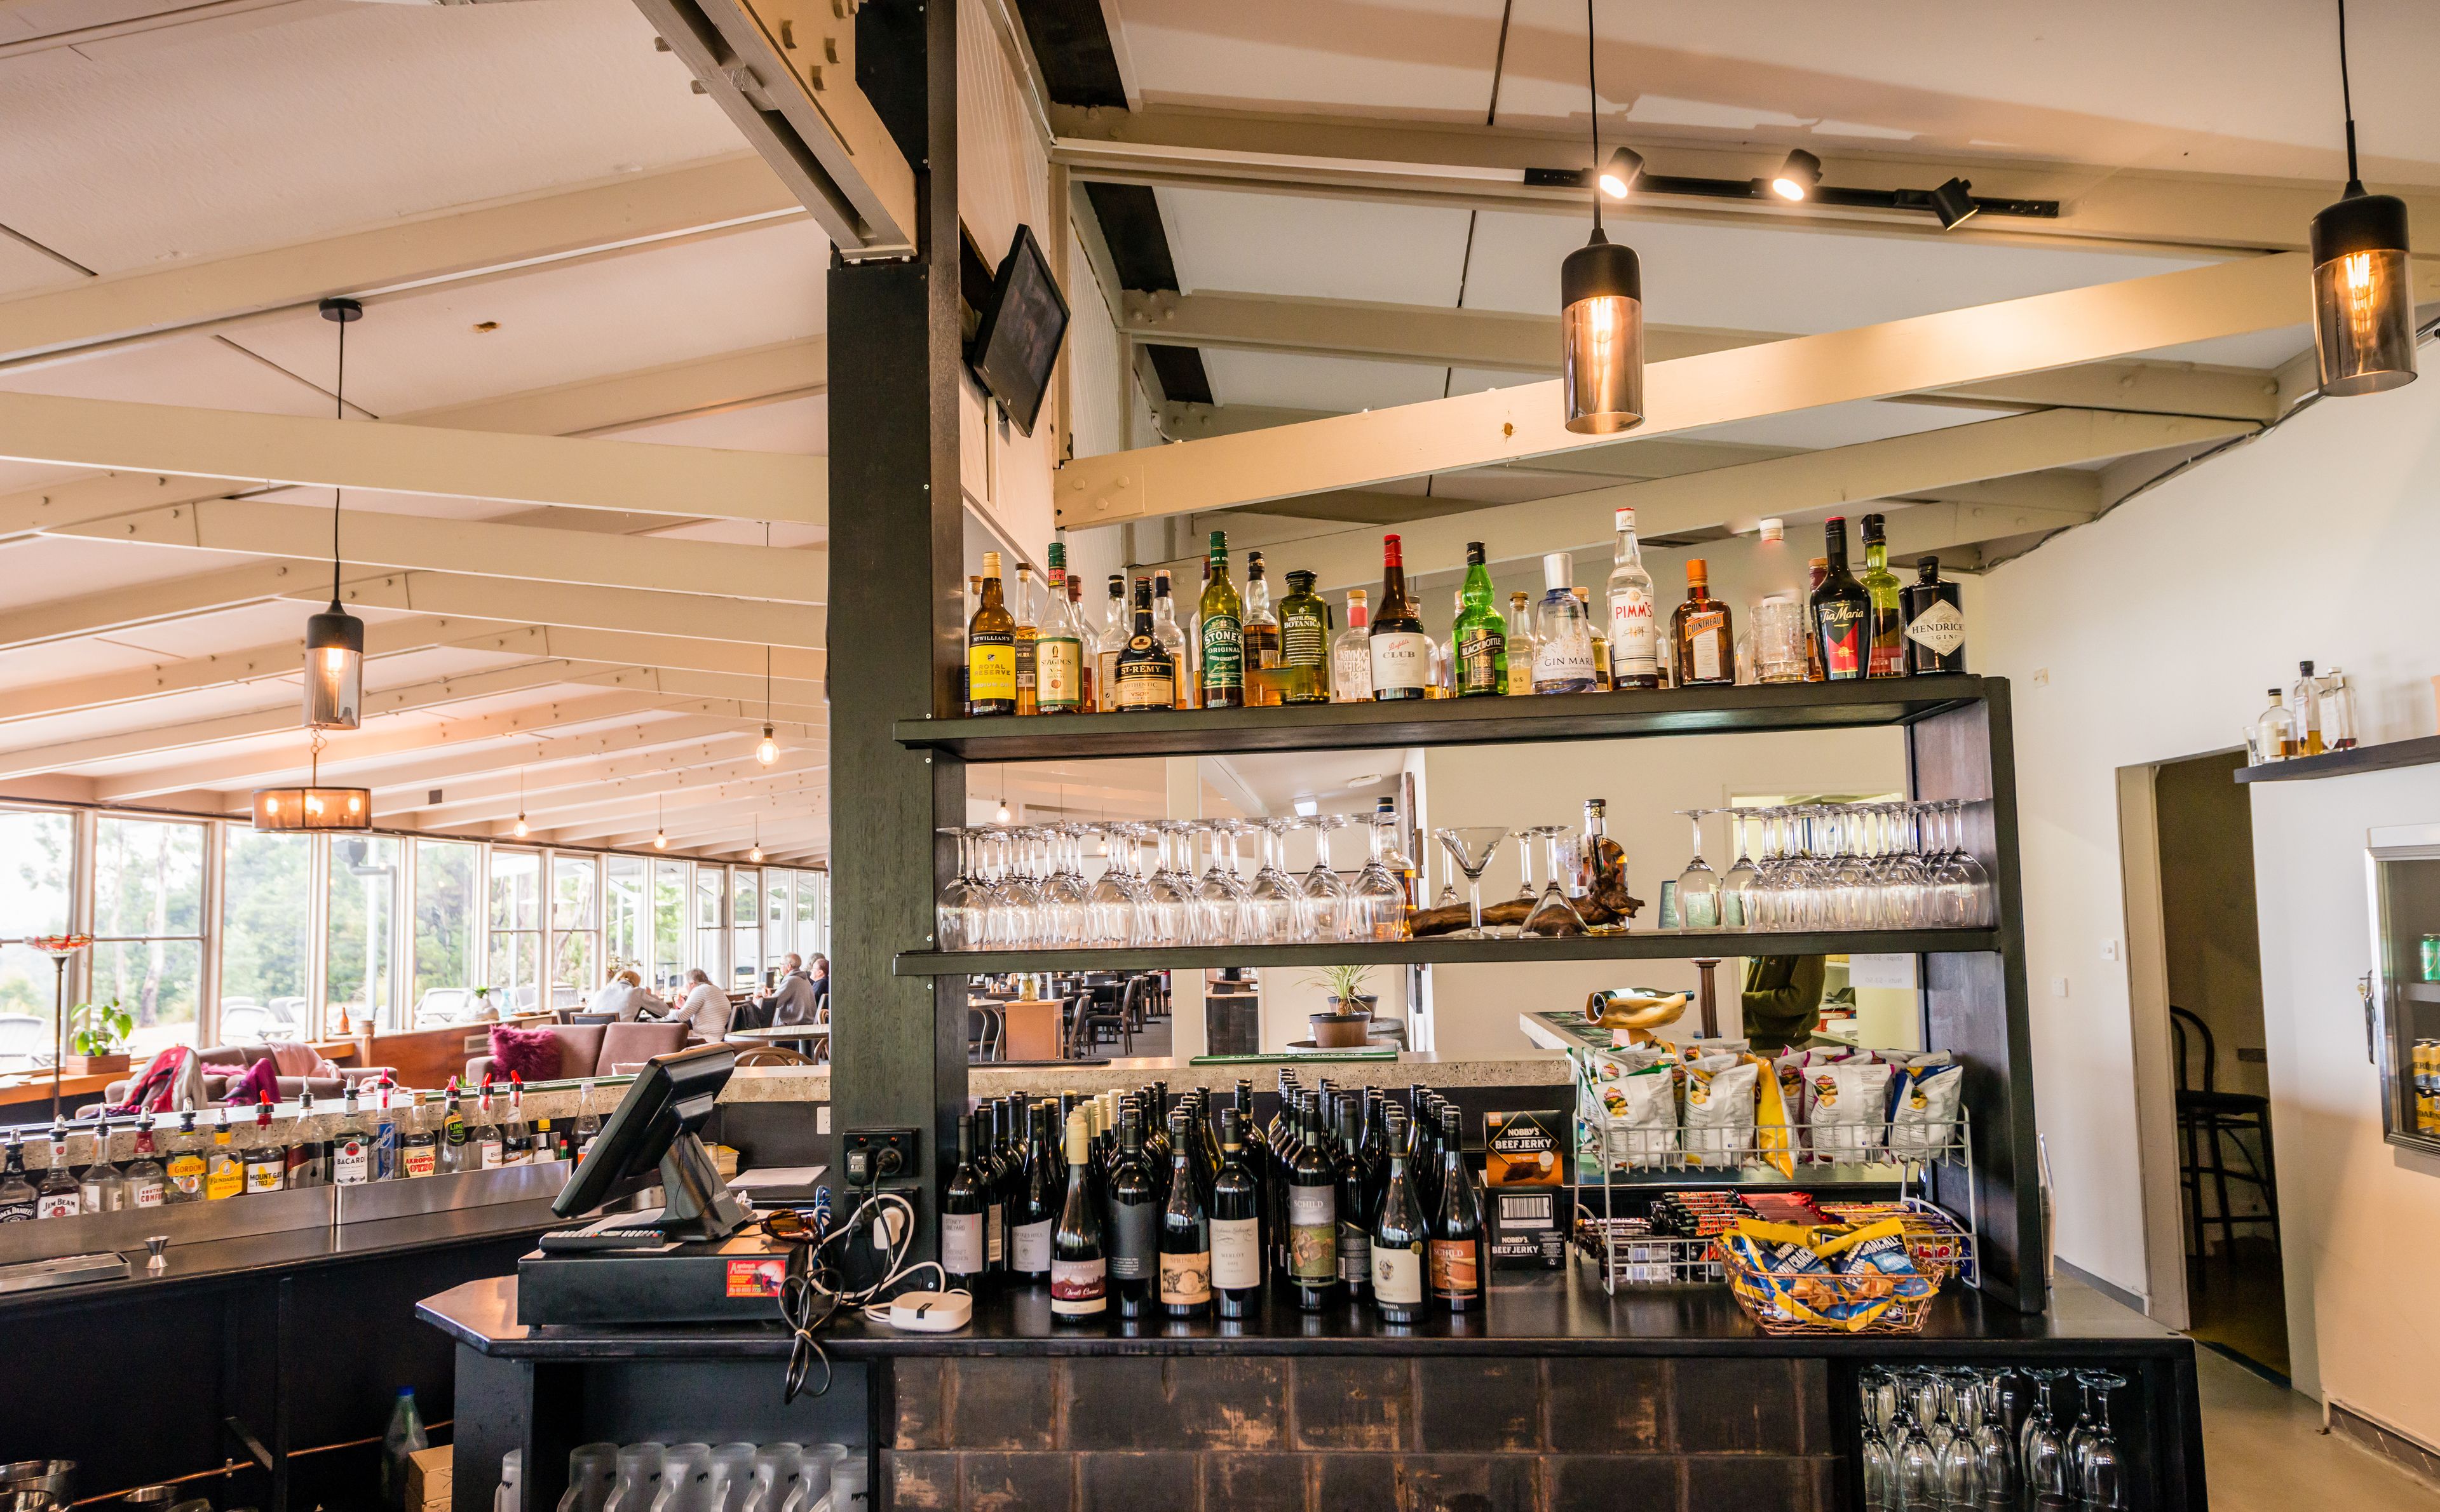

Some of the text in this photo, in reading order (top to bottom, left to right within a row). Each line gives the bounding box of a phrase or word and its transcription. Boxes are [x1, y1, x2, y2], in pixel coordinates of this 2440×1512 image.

[1616, 602, 1652, 619] PIMM'S
[1819, 606, 1864, 623] Tia Maria
[1284, 620, 1321, 628] BOTANICA
[1687, 616, 1721, 636] COINTREAU
[1912, 623, 1963, 634] HENDRICK
[1205, 631, 1242, 645] STONE'S
[1462, 638, 1501, 656] BLACK BOTTLE
[1545, 657, 1594, 666] GIN MARE
[1507, 1126, 1540, 1137] NOBBY'S
[1495, 1138, 1552, 1150] BEEF JERKY
[249, 1173, 271, 1181] MOUNT
[43, 1198, 76, 1212] JIM BEAM
[0, 1209, 11, 1218] ACK
[1492, 1245, 1538, 1254] BEEF JERKY
